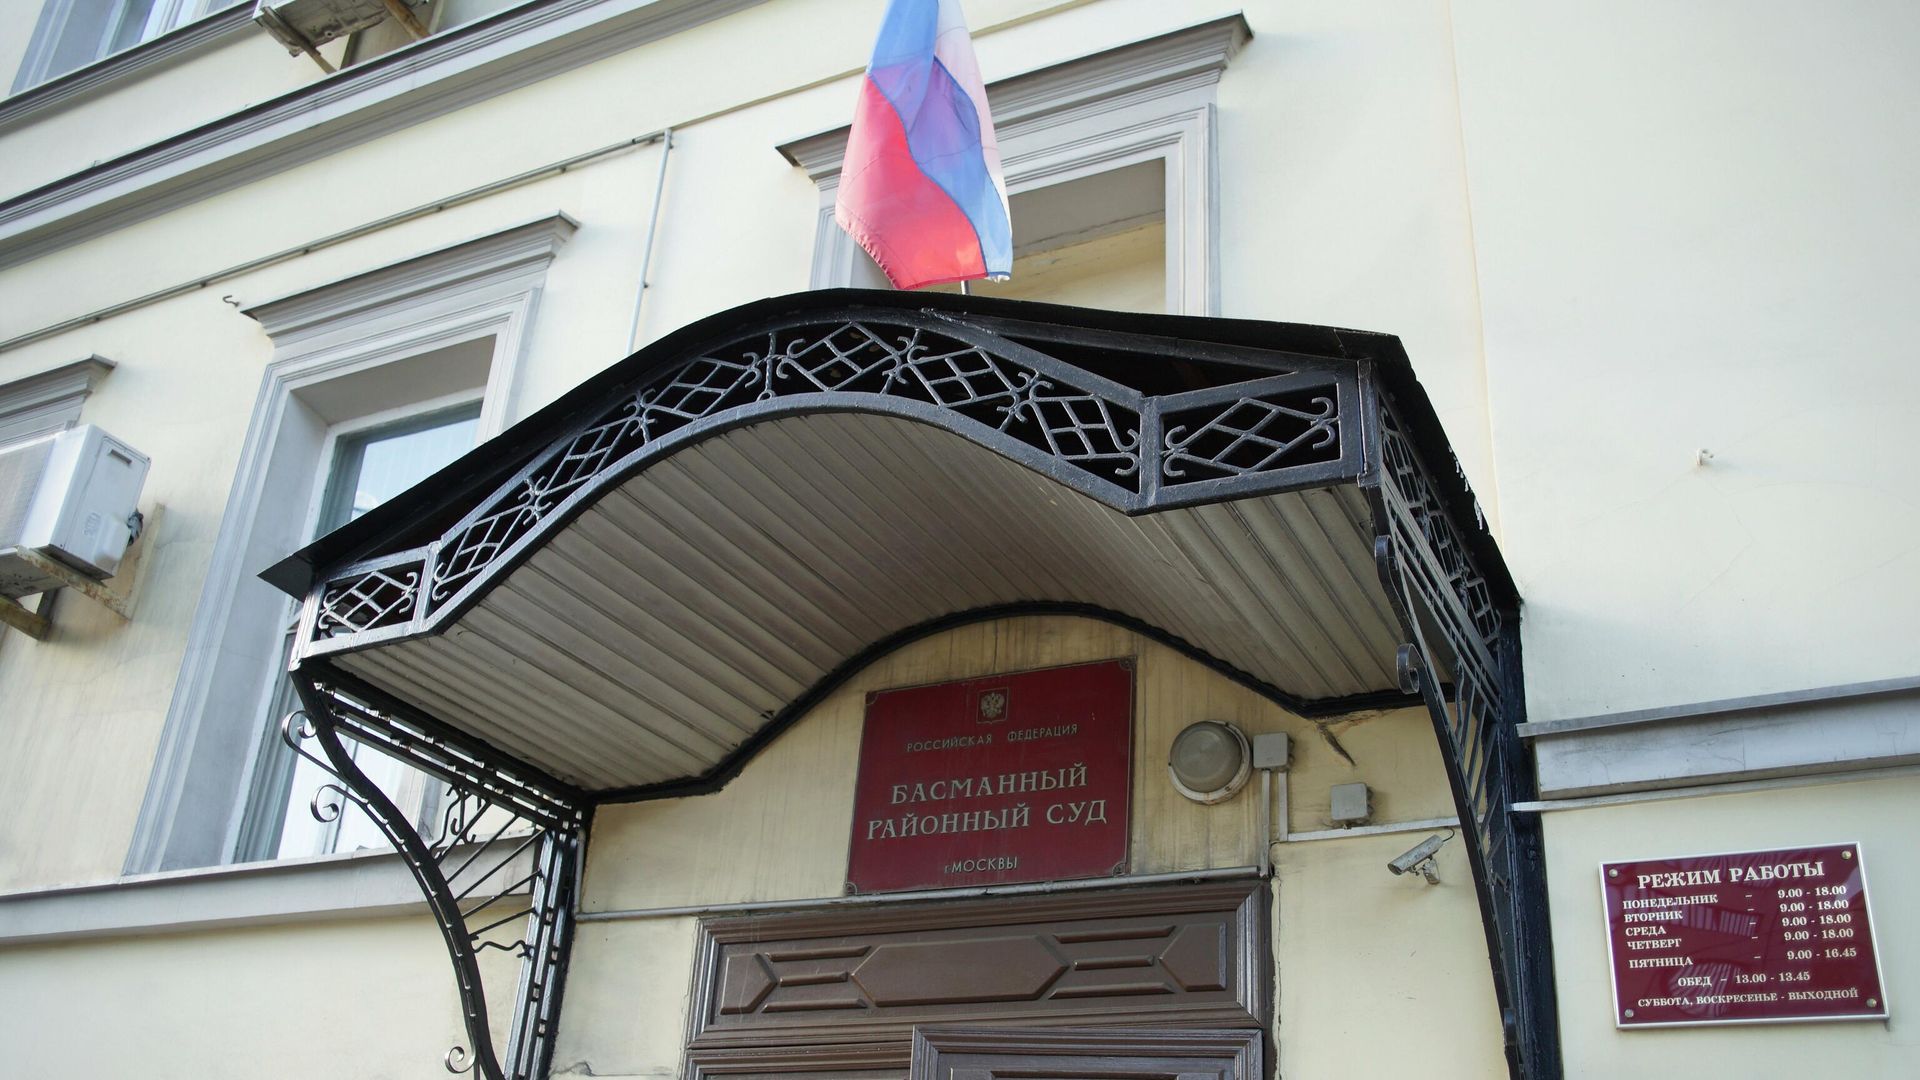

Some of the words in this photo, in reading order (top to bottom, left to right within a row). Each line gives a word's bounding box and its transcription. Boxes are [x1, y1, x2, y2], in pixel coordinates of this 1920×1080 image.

[906, 733, 993, 753] РОССИЙСКАЯ
[1007, 724, 1079, 742] ФЕДЕРАЦИЯ
[891, 762, 1088, 805] БАСМАННЫЙ
[867, 802, 1030, 841] РАЙОННЫЙ
[1046, 799, 1107, 826] СУД
[1637, 869, 1721, 889] РЕЖИМ
[1729, 861, 1825, 882] РАБОТЫ
[1622, 894, 1718, 910] ПОНЕДЕЛЬНИК
[1777, 888, 1803, 899] 9.00
[1814, 885, 1847, 896] 18.00
[1624, 910, 1684, 923] ВТОРНИК
[1779, 902, 1805, 913] 9.00
[1816, 899, 1849, 911] 18.00
[1625, 926, 1667, 937] СРЕДА
[1781, 916, 1807, 927] 9.00
[1819, 913, 1852, 925] 18.00
[1627, 938, 1682, 951] ЧЕТВЕРГ
[1784, 930, 1809, 941] 9.00
[1821, 928, 1854, 939] 18.00
[1628, 956, 1694, 969] ПЯТНИЦА
[1787, 949, 1813, 960] 9.00
[1824, 947, 1857, 959] 16.45
[1677, 976, 1712, 988] ОБЕД
[1735, 973, 1767, 984] 13.00
[1778, 971, 1810, 982] 13.45
[1637, 996, 1694, 1008] СУББОТА,
[1696, 991, 1778, 1005] ВОСКРЕСЕНЬЕ
[1788, 987, 1859, 1000] ВЫХОДНОЙ
